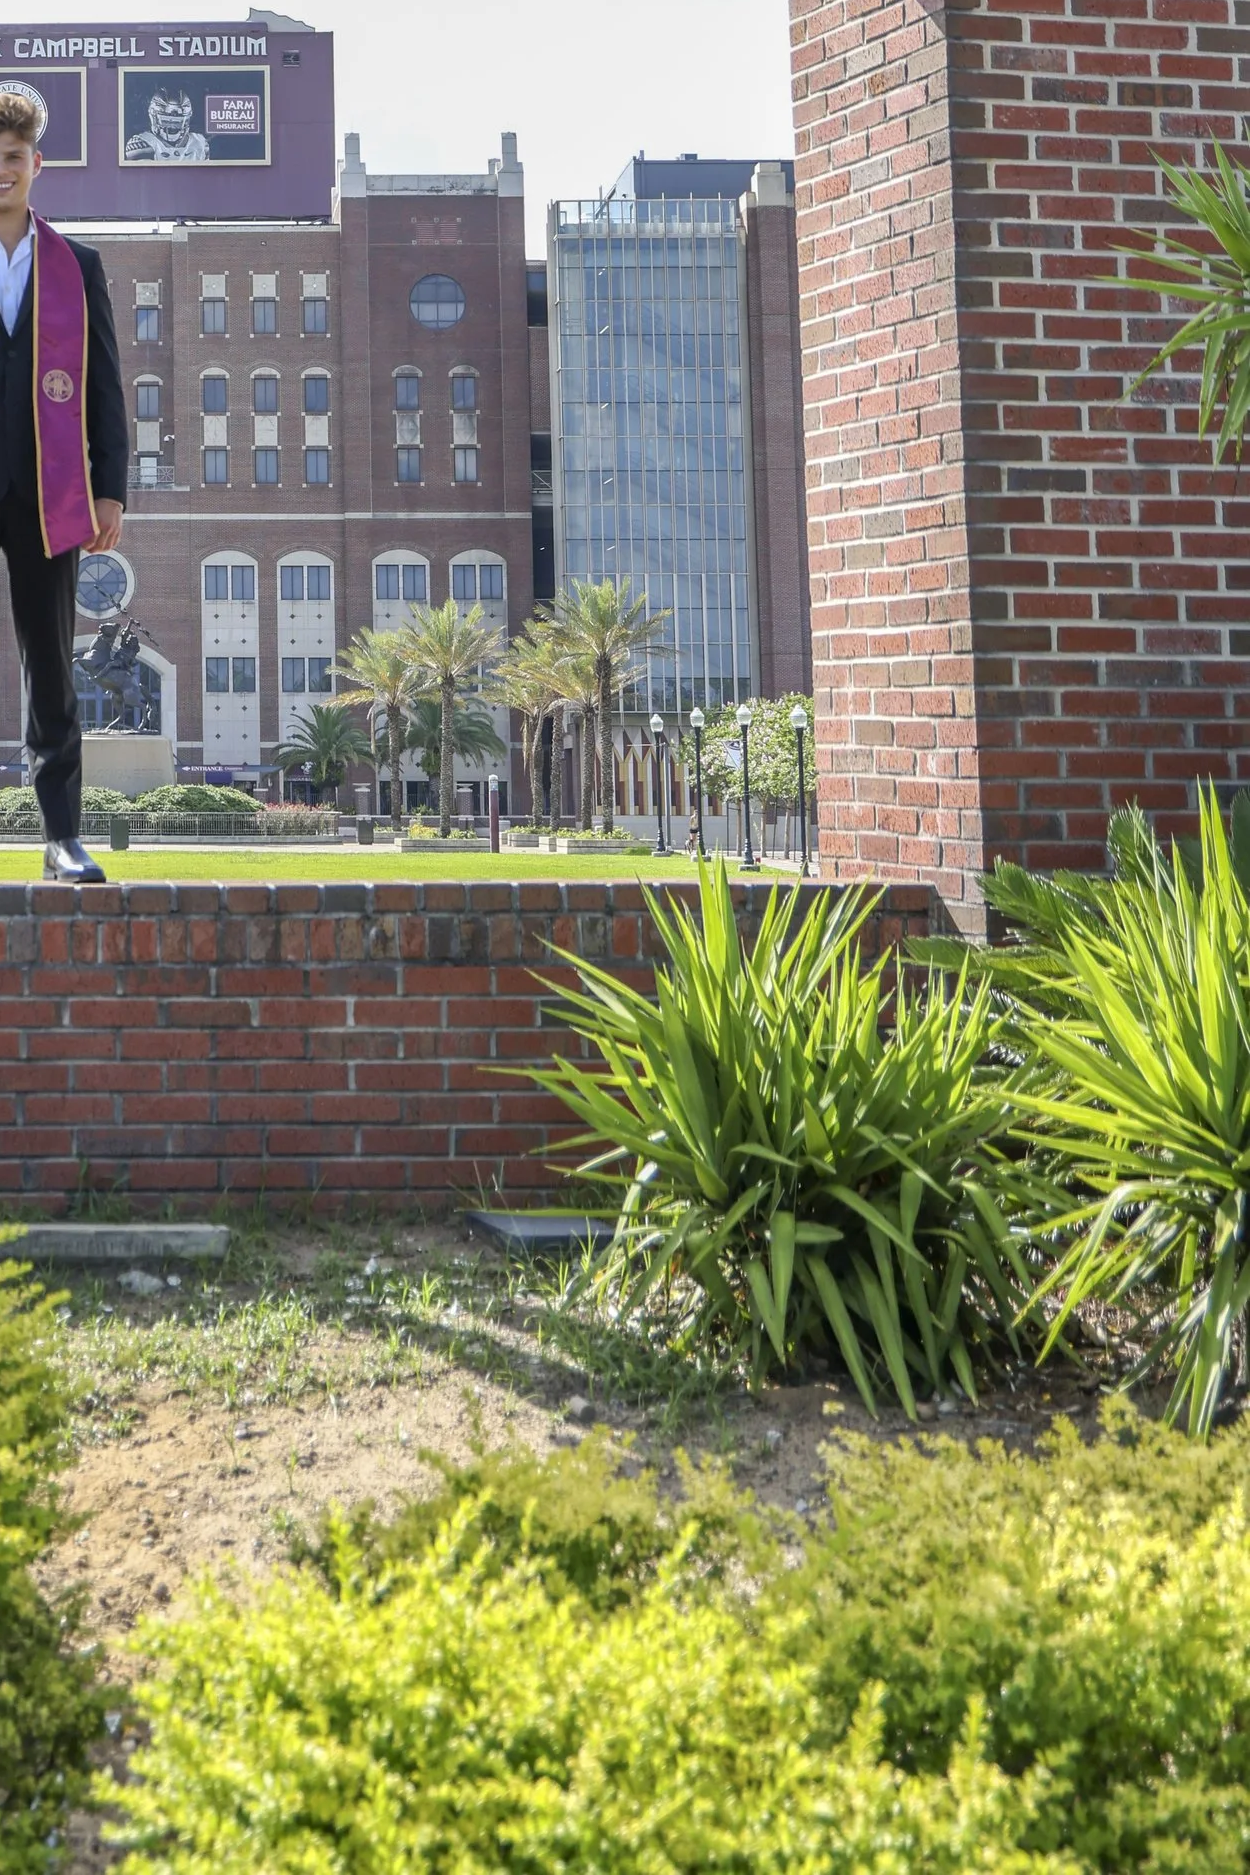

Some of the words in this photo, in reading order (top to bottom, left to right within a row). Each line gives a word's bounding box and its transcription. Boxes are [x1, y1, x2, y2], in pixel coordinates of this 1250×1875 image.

[13, 37, 146, 58] CAMPBELL
[157, 36, 268, 57] STADIUM
[223, 100, 255, 110] FARM
[210, 110, 255, 120] BUREAU
